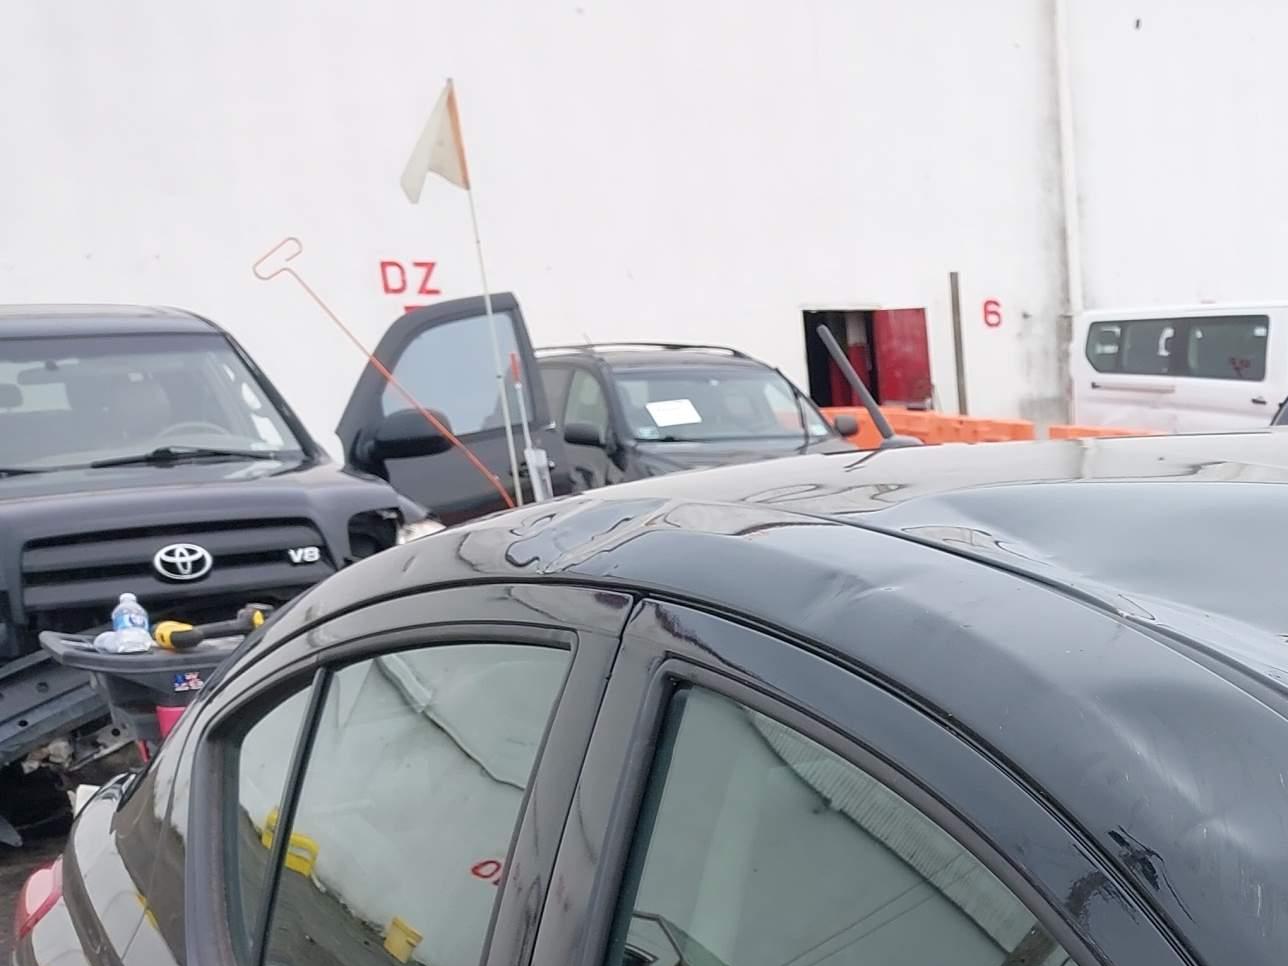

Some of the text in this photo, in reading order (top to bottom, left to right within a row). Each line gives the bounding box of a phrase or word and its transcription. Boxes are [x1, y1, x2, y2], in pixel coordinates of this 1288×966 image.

[380, 261, 442, 294] DZ
[983, 300, 1002, 327] 6
[288, 546, 321, 563] V8
